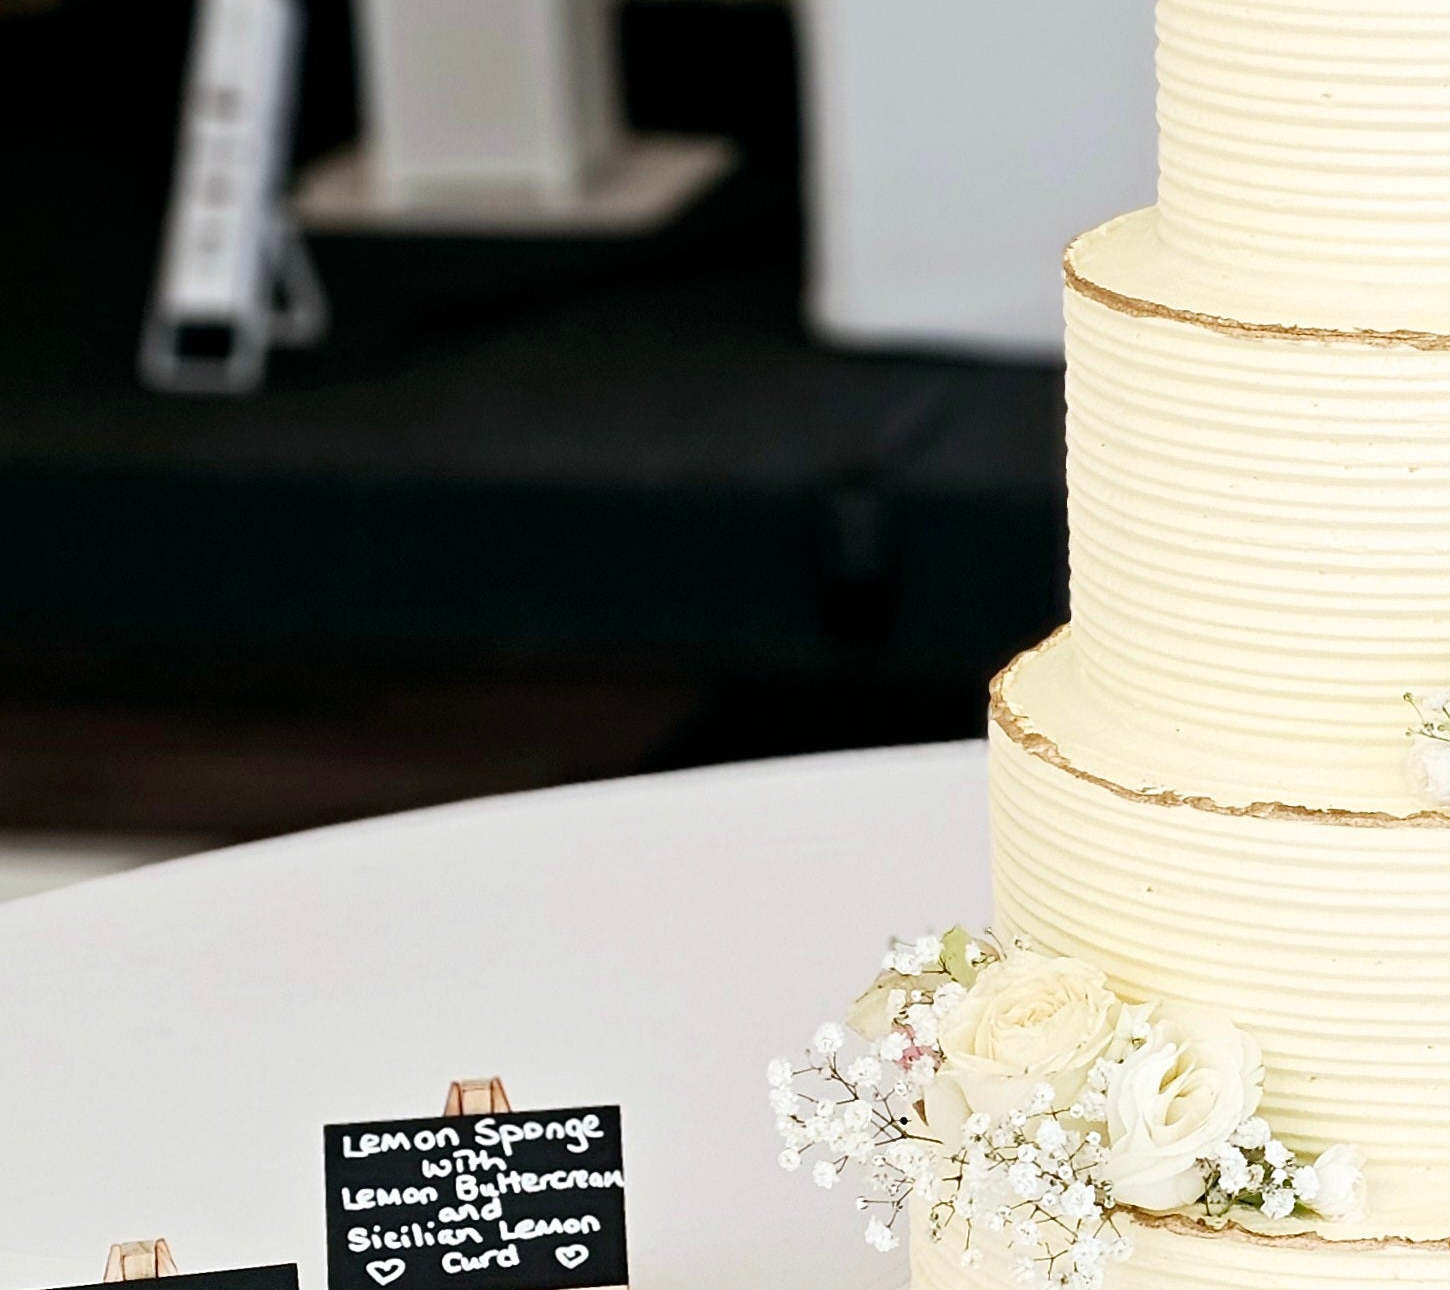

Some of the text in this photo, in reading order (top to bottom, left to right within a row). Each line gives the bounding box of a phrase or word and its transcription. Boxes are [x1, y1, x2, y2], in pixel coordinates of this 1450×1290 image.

[475, 1115, 604, 1156] Sponge
[422, 1149, 507, 1178] with
[438, 1198, 502, 1223] and
[348, 1222, 483, 1252] Sicilian
